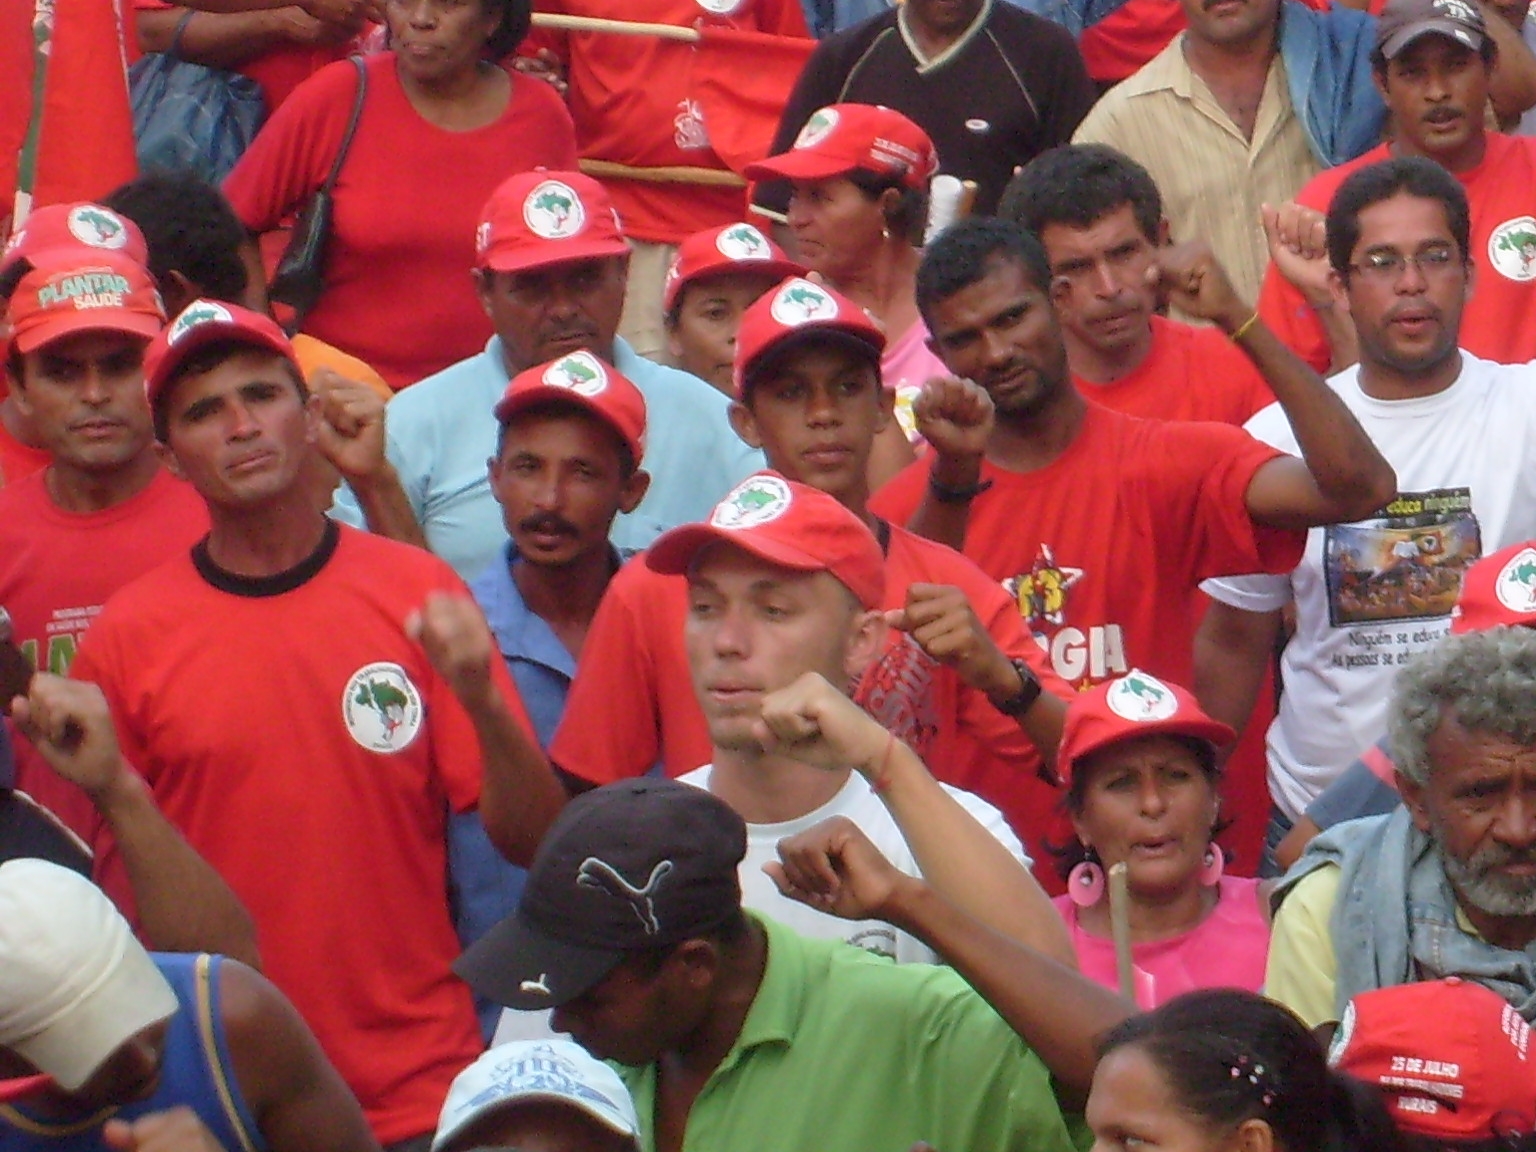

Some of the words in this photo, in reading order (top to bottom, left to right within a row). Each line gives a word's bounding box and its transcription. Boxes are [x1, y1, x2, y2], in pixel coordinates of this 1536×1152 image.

[38, 273, 132, 308] PLANTAR
[1349, 628, 1393, 651] Ninguém
[1396, 632, 1409, 644] se
[1345, 653, 1379, 670] pessoas
[1405, 1057, 1423, 1074] DE
[1423, 1059, 1460, 1079] JULHO
